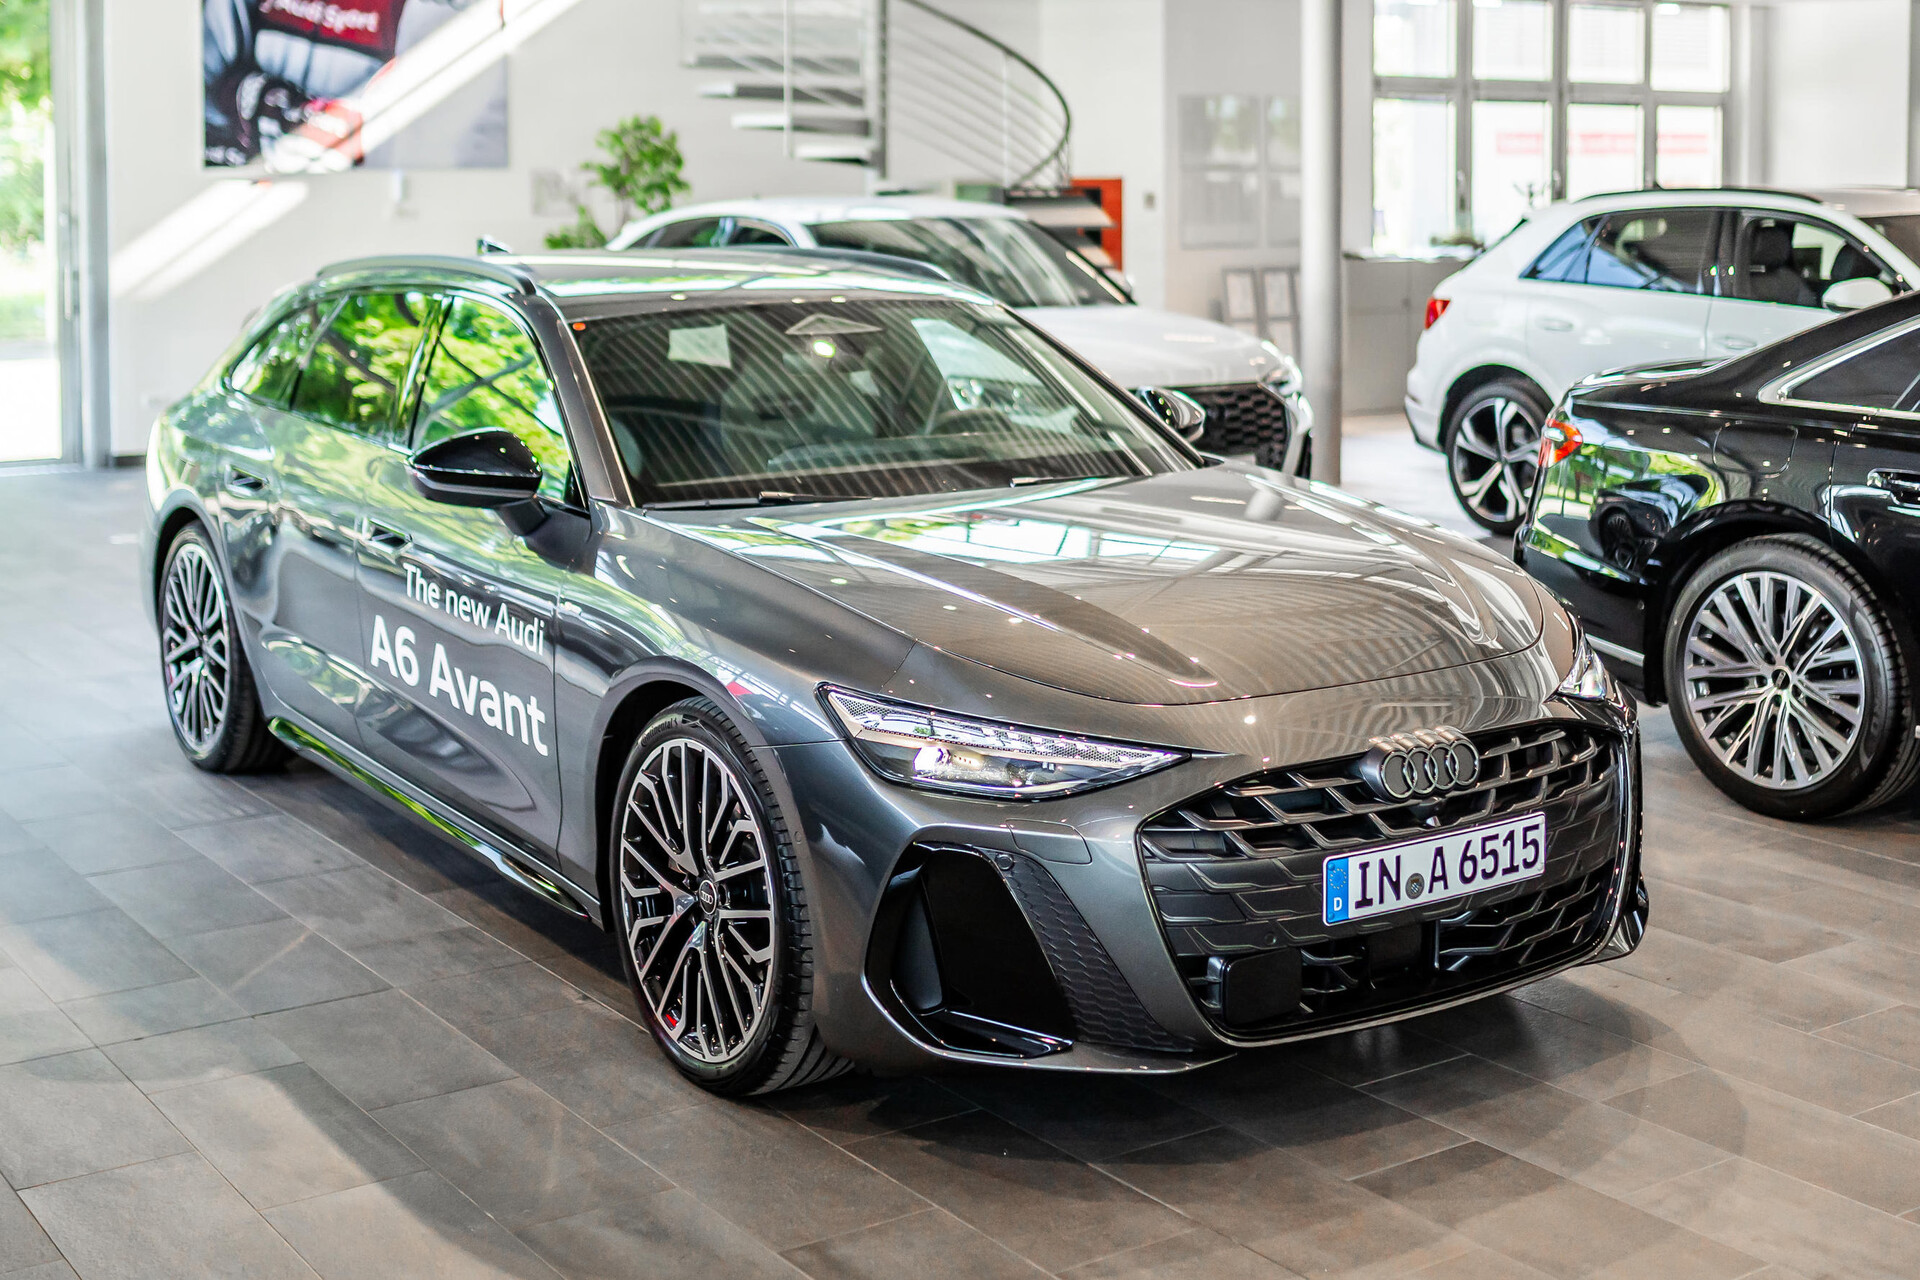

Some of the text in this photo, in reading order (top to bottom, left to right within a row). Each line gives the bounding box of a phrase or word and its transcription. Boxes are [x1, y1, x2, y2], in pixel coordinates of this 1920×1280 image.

[322, 4, 379, 33] Sport
[403, 562, 545, 656] The new Audi
[370, 615, 548, 756] A6 Avant
[1333, 897, 1343, 911] D
[1354, 824, 1540, 910] IN A 6515
